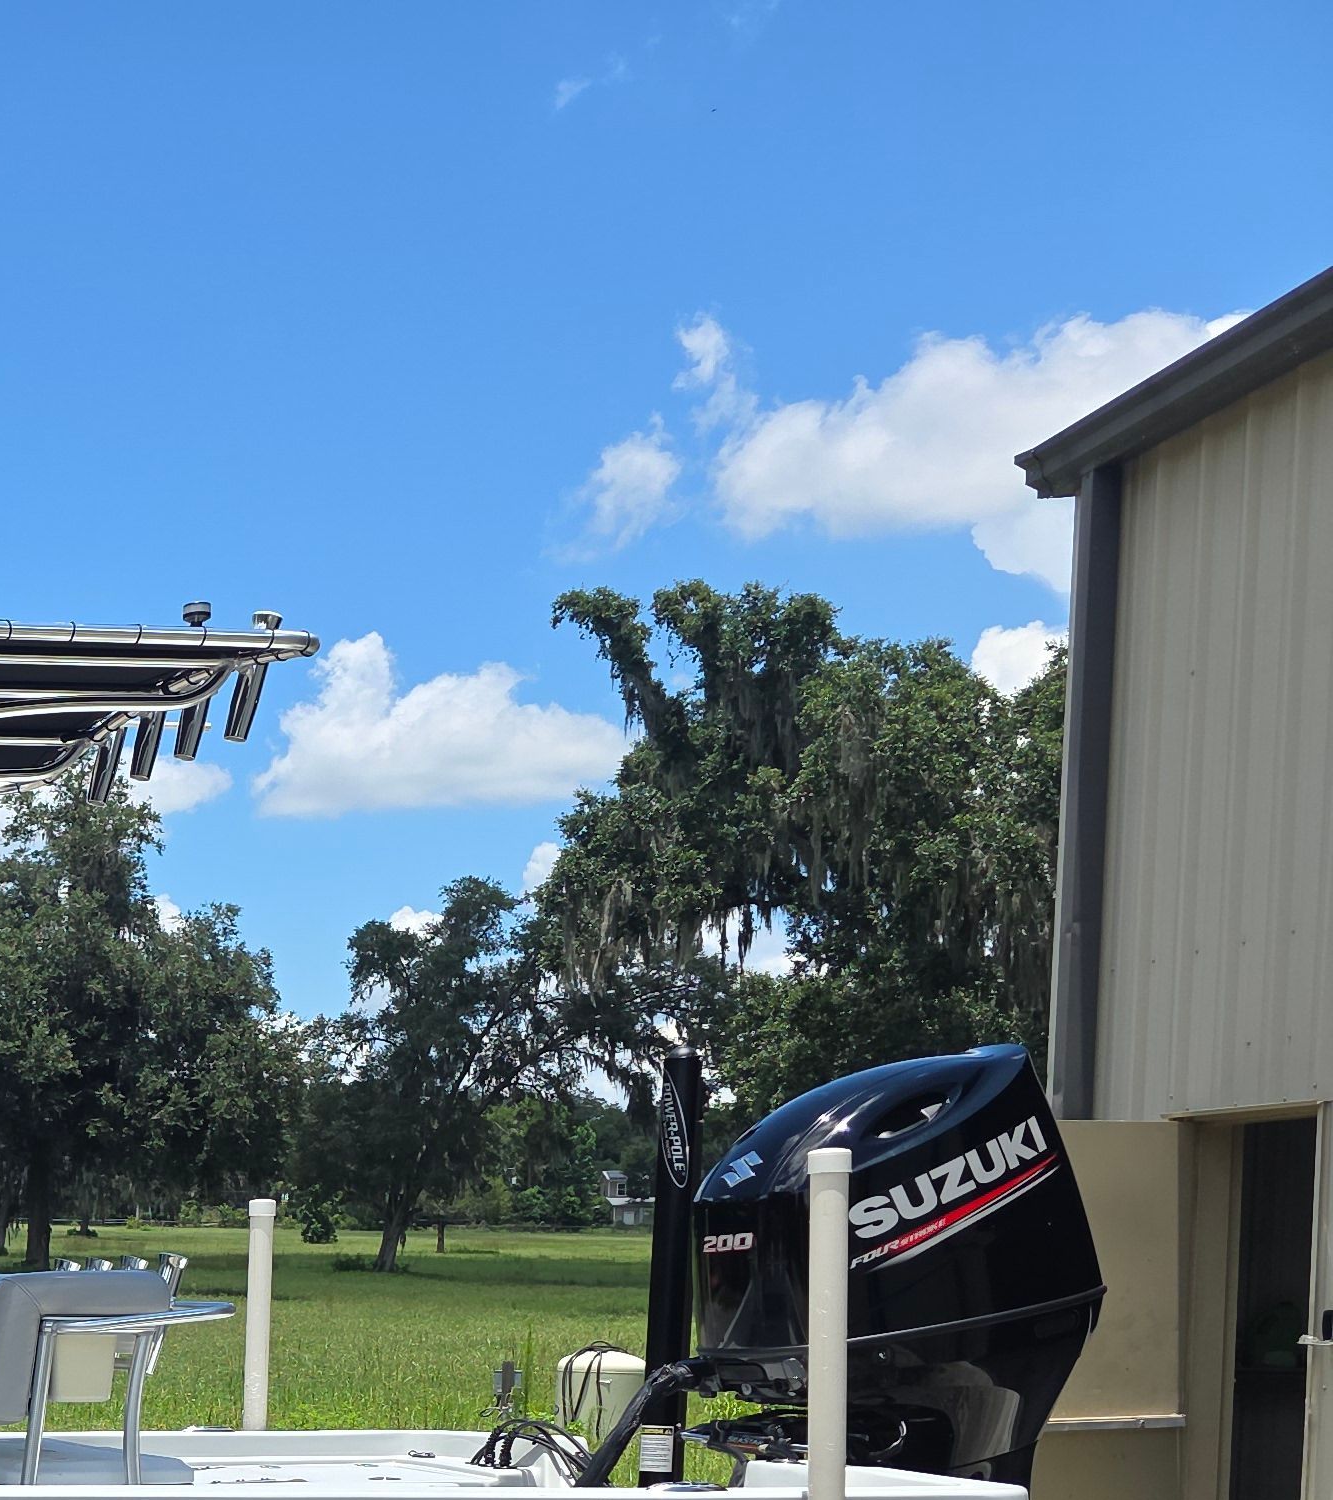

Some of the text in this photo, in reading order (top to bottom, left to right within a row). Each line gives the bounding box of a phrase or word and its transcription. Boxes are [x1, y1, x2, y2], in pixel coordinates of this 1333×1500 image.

[848, 1115, 1048, 1239] SUZUKI
[702, 1232, 754, 1253] 200
[850, 1239, 900, 1270] FOUR
